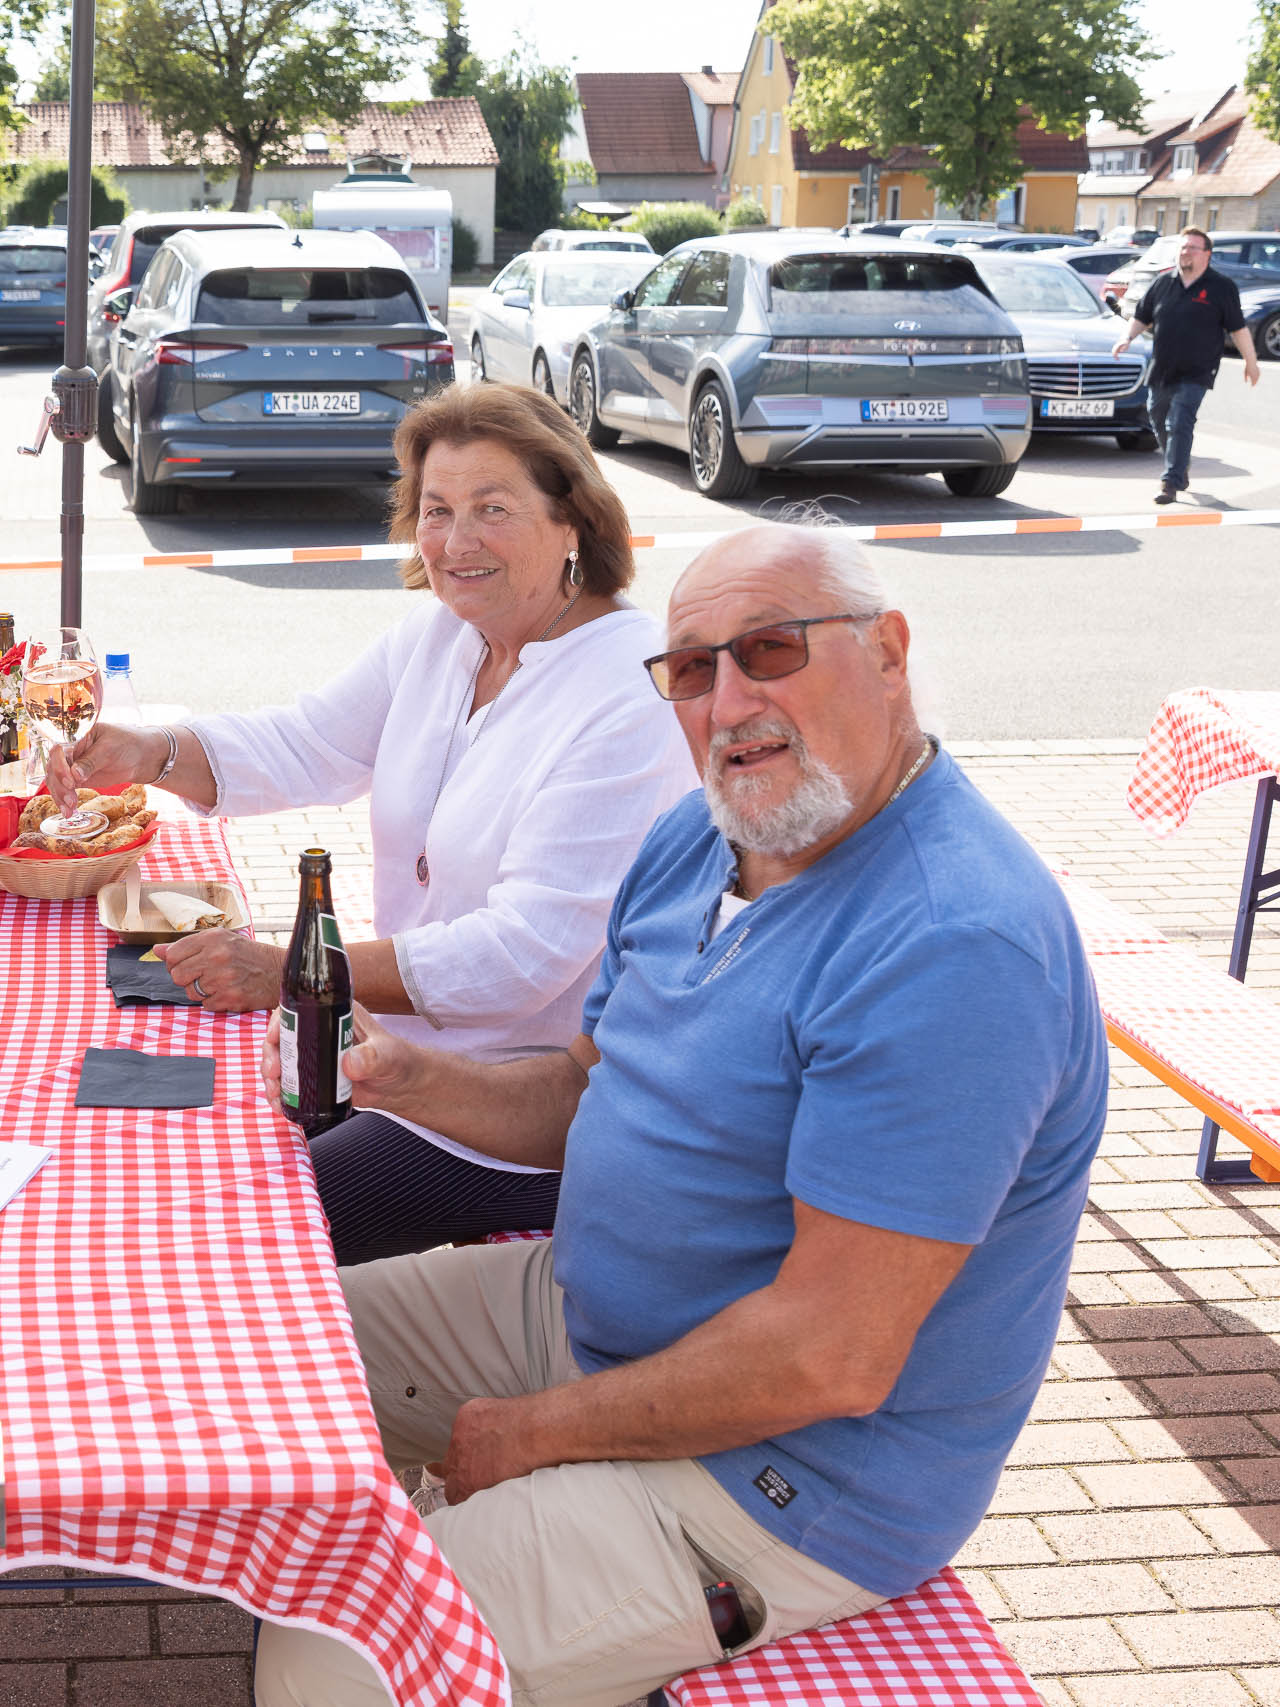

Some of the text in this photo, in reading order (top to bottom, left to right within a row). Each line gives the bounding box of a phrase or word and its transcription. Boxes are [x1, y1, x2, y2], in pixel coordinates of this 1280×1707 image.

[272, 394, 358, 410] KT UA 224E
[871, 402, 889, 416] KT
[919, 402, 946, 416] 92E
[1051, 402, 1067, 415] KT
[1093, 402, 1109, 415] 69
